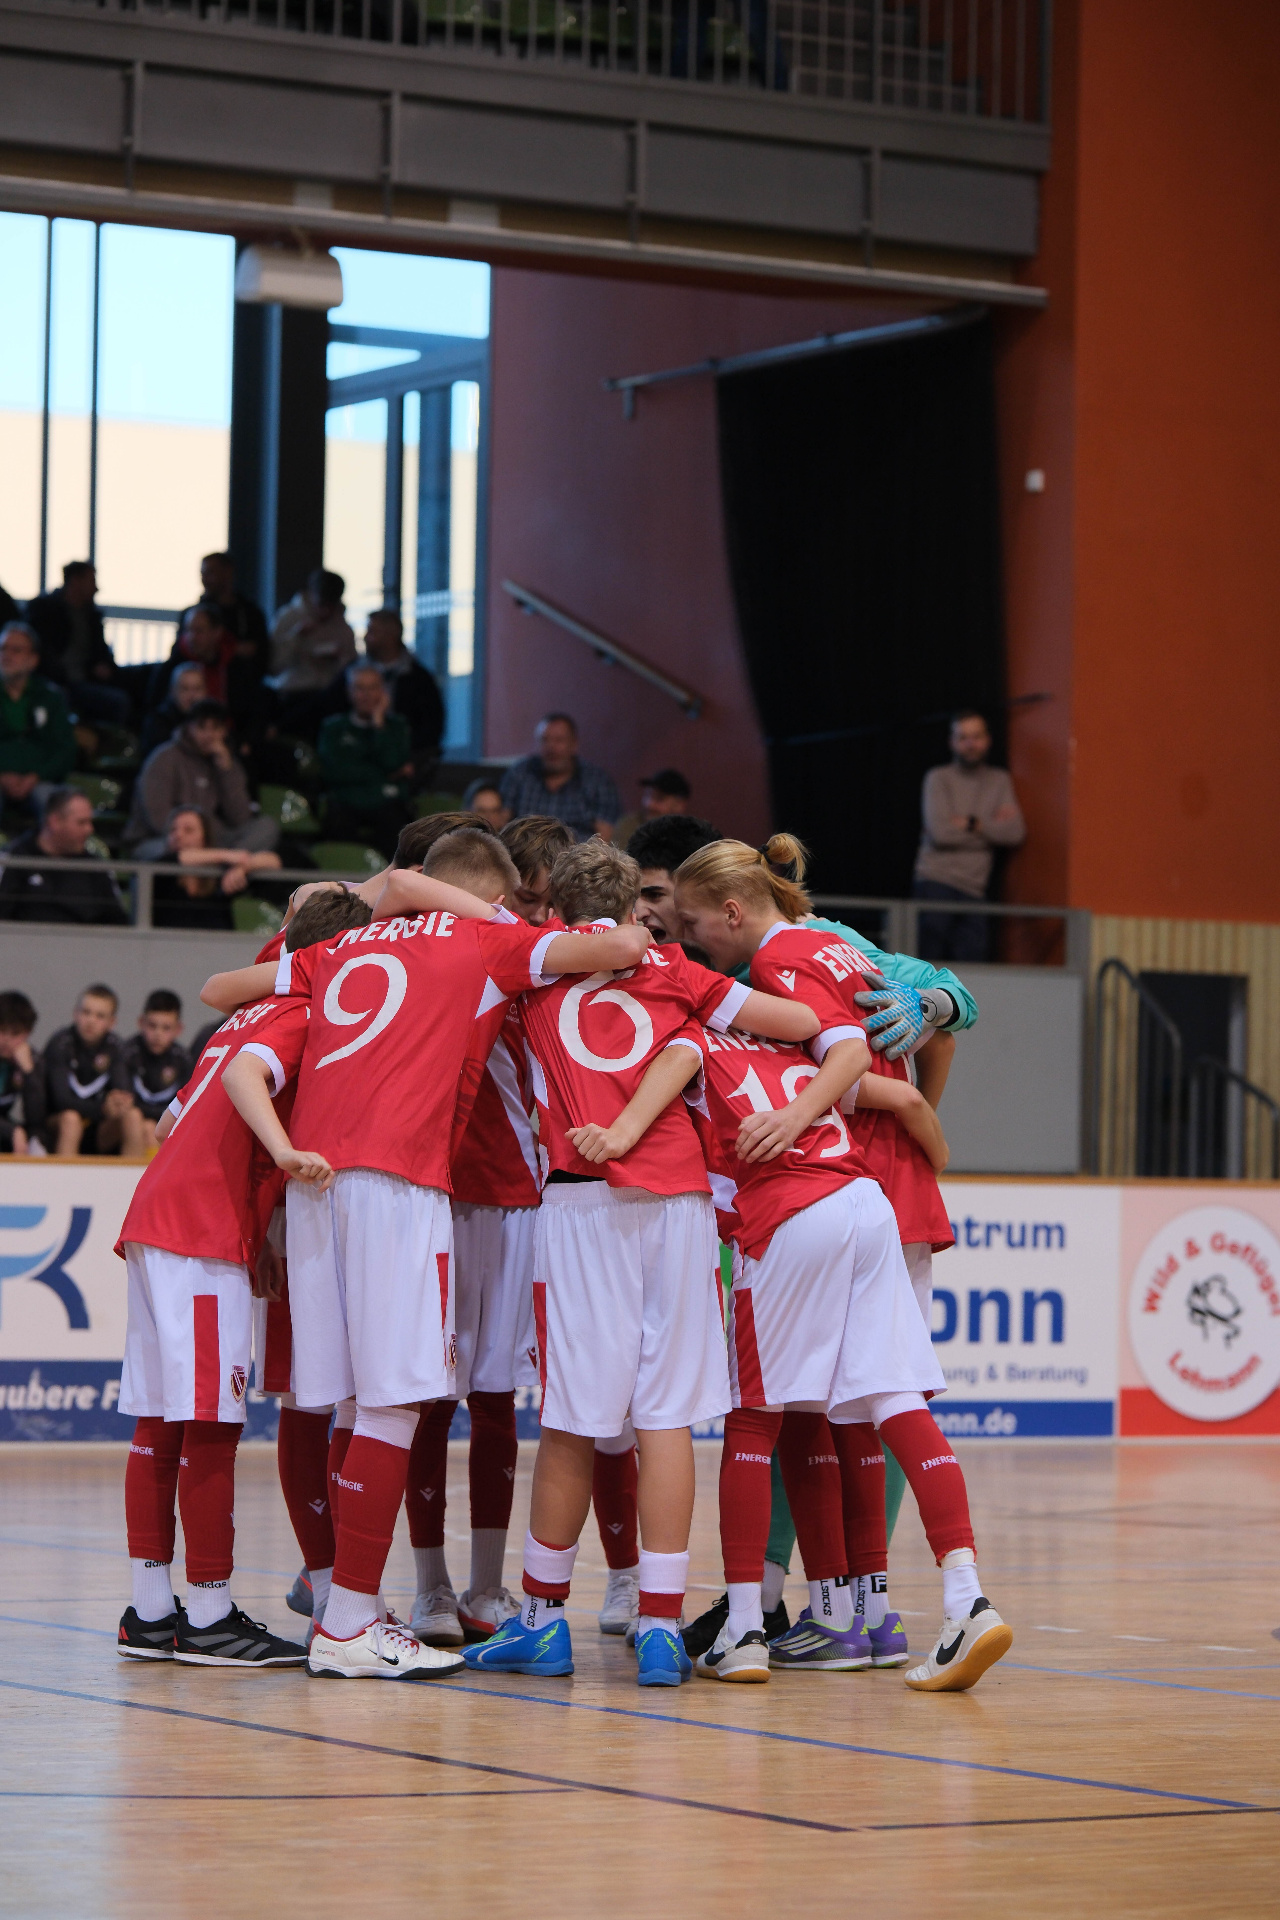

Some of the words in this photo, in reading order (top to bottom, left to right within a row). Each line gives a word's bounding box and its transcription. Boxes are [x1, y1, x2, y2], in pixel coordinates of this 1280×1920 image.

[326, 911, 459, 955] NERGIE
[315, 953, 408, 1070] 9
[558, 969, 654, 1073] 6
[168, 1044, 231, 1139] 7
[1143, 1255, 1181, 1314] Wild
[1186, 1238, 1201, 1258] &
[986, 1363, 998, 1381] &
[1007, 1364, 1088, 1386] Beratung
[1169, 1352, 1262, 1391] Lehmann
